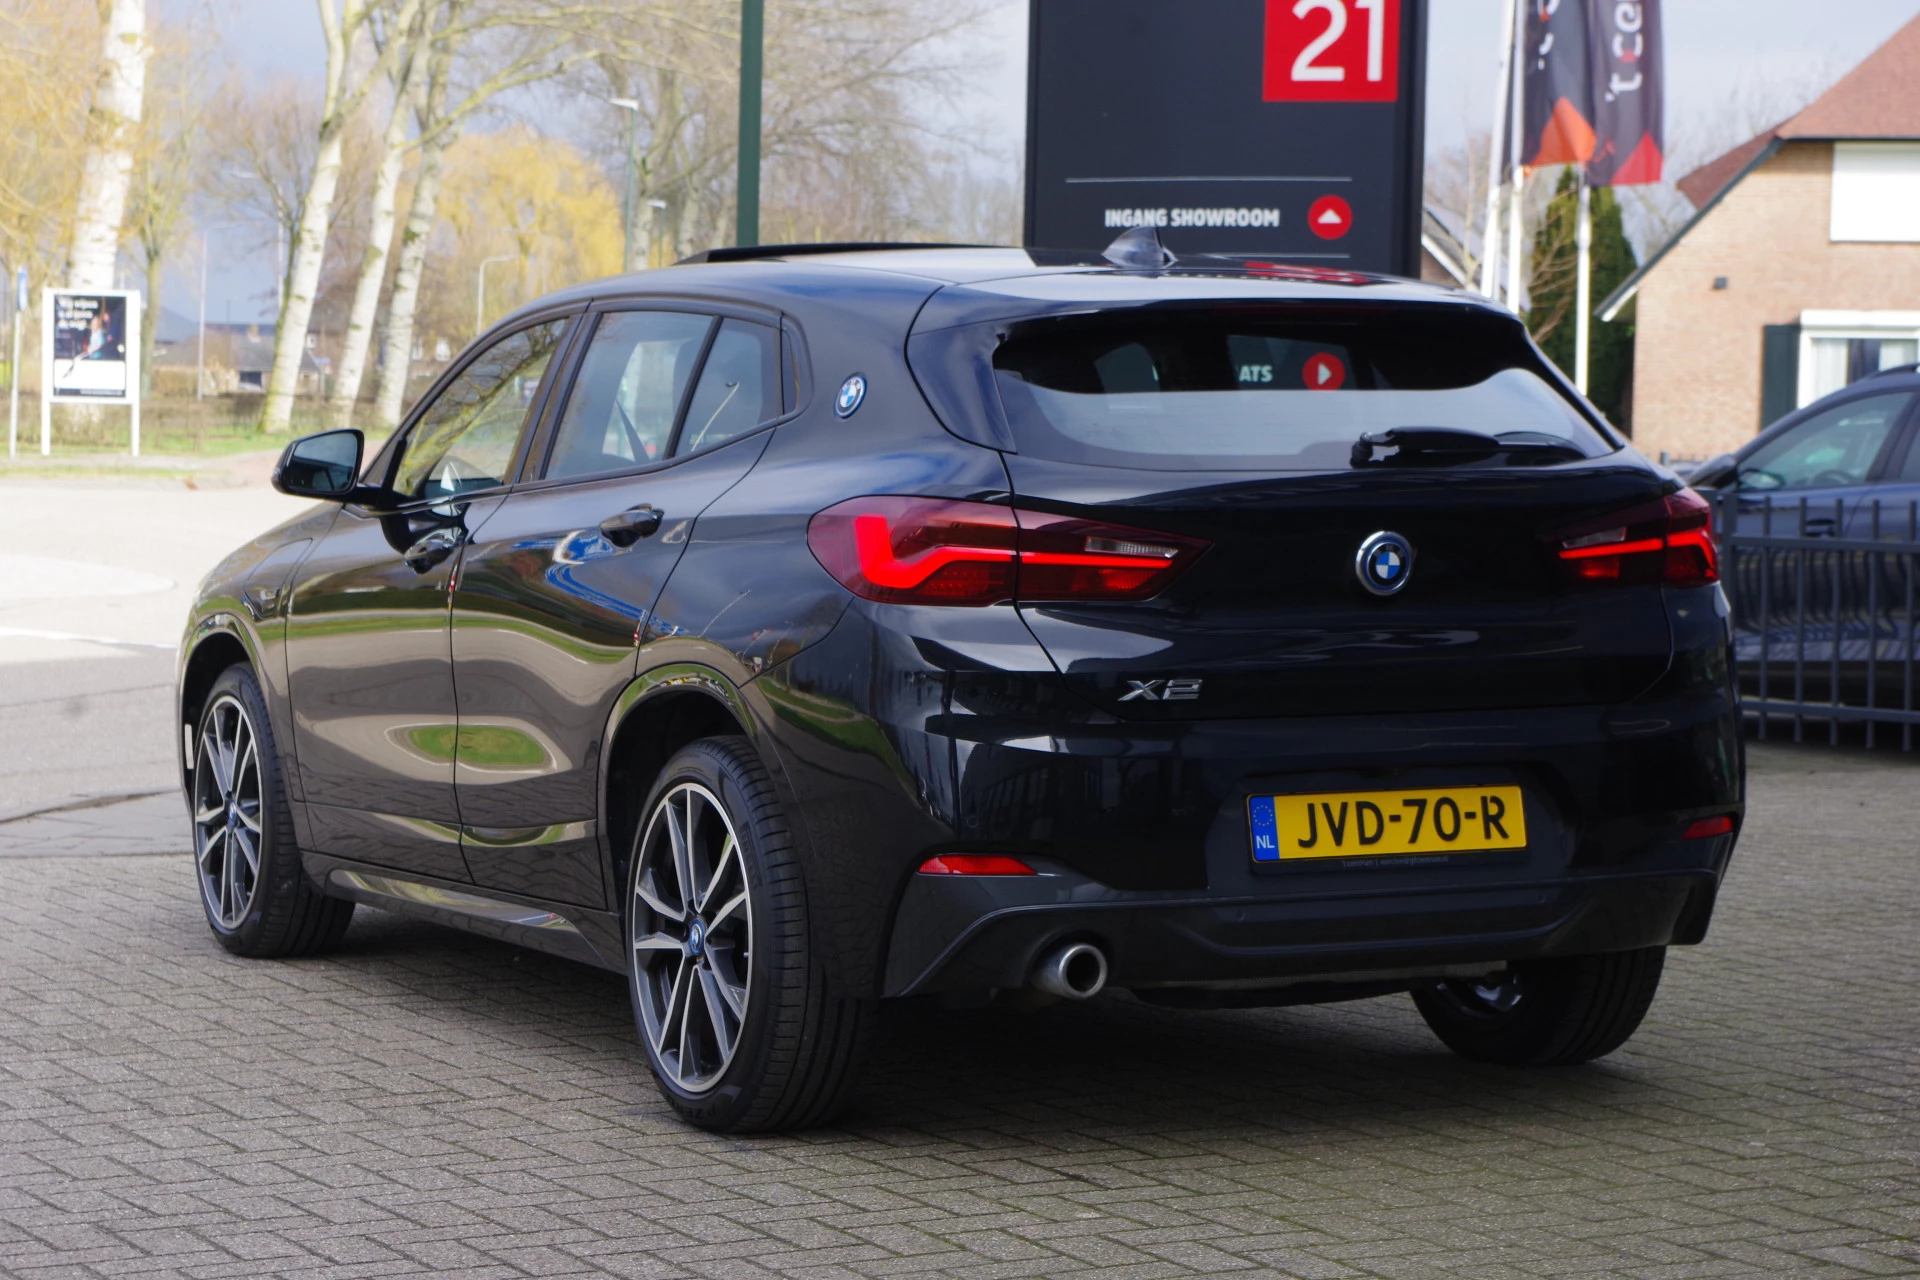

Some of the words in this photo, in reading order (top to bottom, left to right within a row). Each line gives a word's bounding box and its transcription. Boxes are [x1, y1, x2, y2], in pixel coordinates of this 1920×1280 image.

[1291, 0, 1384, 82] 21
[1612, 0, 1643, 62] ce
[1105, 208, 1168, 228] INGANG
[1170, 208, 1280, 228] SHOWROOM
[1238, 364, 1273, 382] ATS
[1117, 679, 1203, 701] X2
[1298, 796, 1509, 848] JVD-70-R
[1256, 835, 1275, 849] NL
